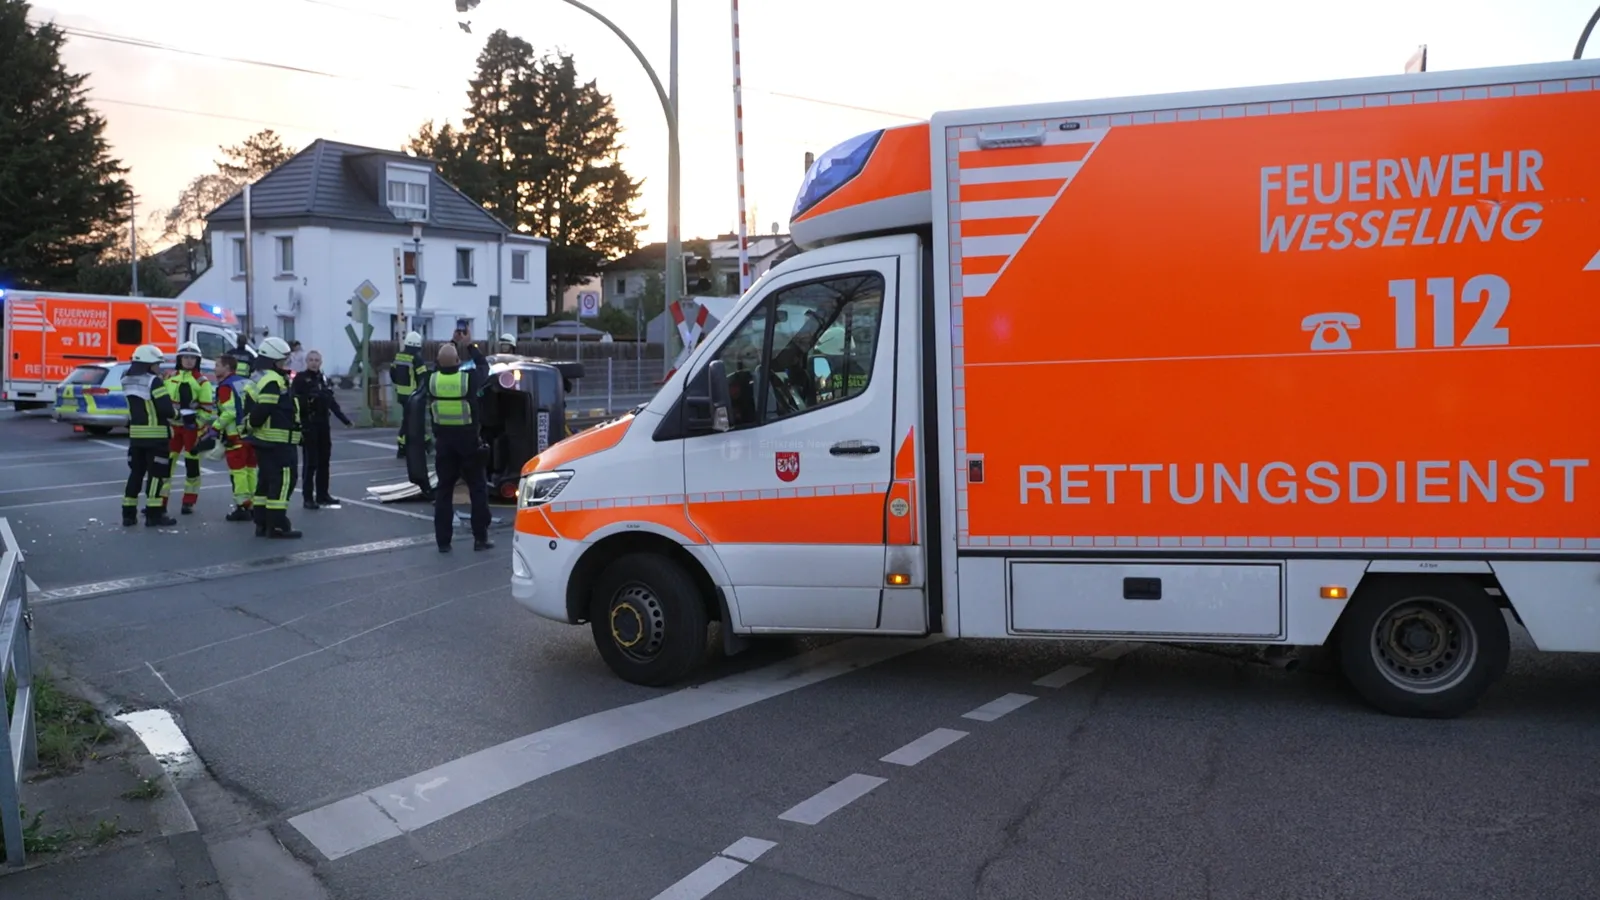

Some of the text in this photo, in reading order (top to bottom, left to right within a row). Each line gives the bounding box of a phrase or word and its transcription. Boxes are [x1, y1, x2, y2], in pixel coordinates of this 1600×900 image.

[1260, 149, 1545, 209] FEUERWEHR
[1260, 201, 1544, 253] WESSELING
[54, 308, 107, 321] FEUERWEHR
[55, 318, 107, 330] WESSELING
[1388, 273, 1510, 348] 112
[78, 331, 102, 347] 112
[1019, 458, 1590, 505] RETTUNGSDIENST
